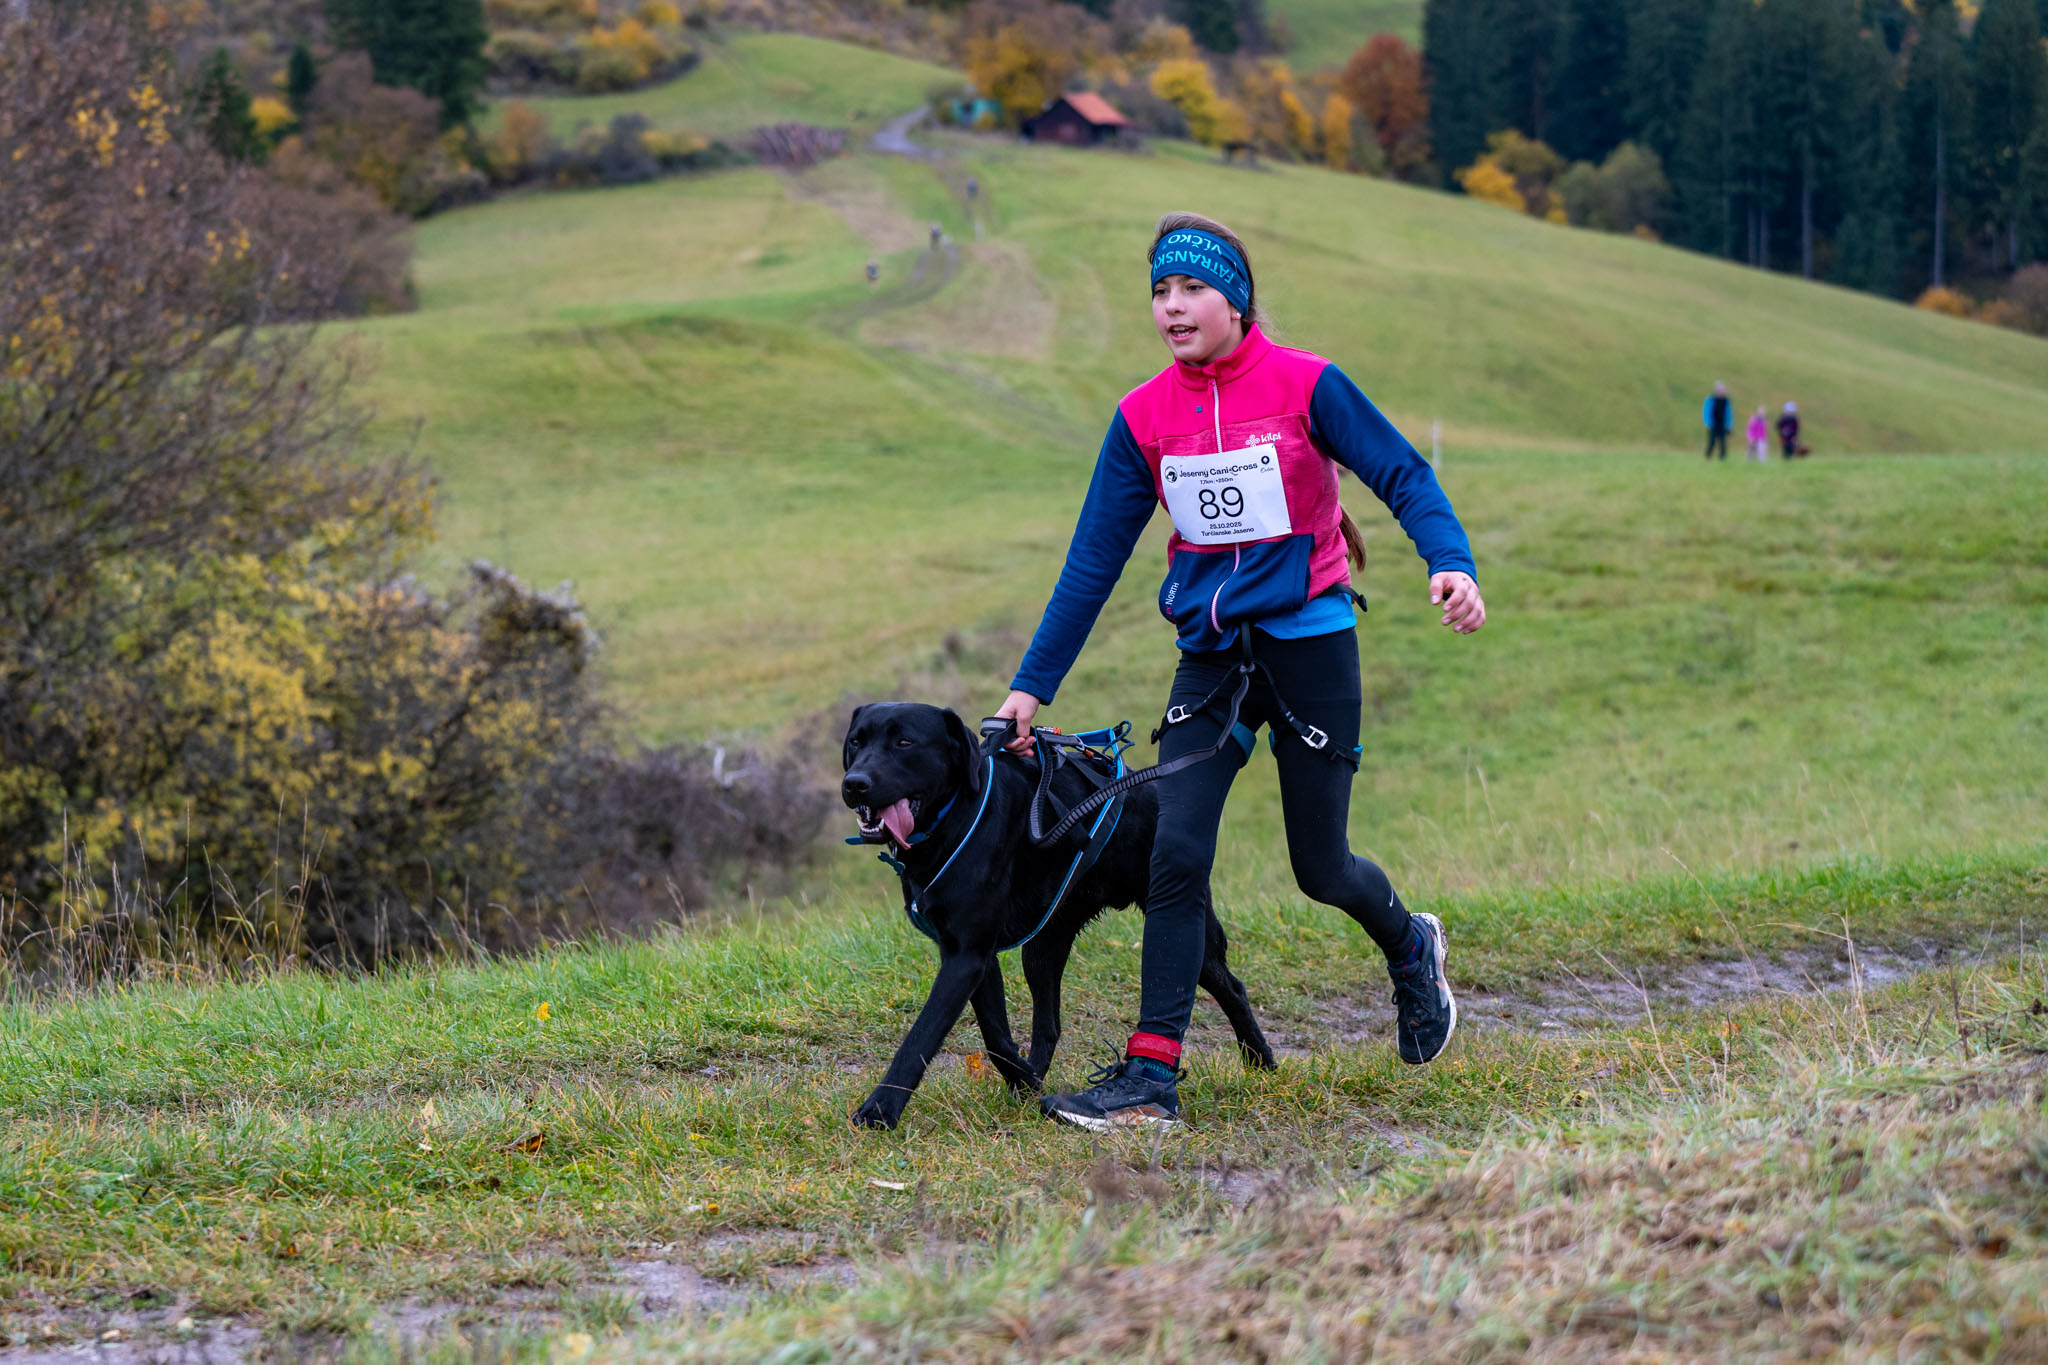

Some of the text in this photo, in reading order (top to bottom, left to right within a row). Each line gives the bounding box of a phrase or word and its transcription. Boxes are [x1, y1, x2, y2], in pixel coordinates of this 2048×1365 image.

[1260, 432, 1282, 443] kilpi
[1198, 486, 1244, 519] 89
[1209, 521, 1242, 530] 25.10.2025
[1165, 582, 1180, 605] NORTH
